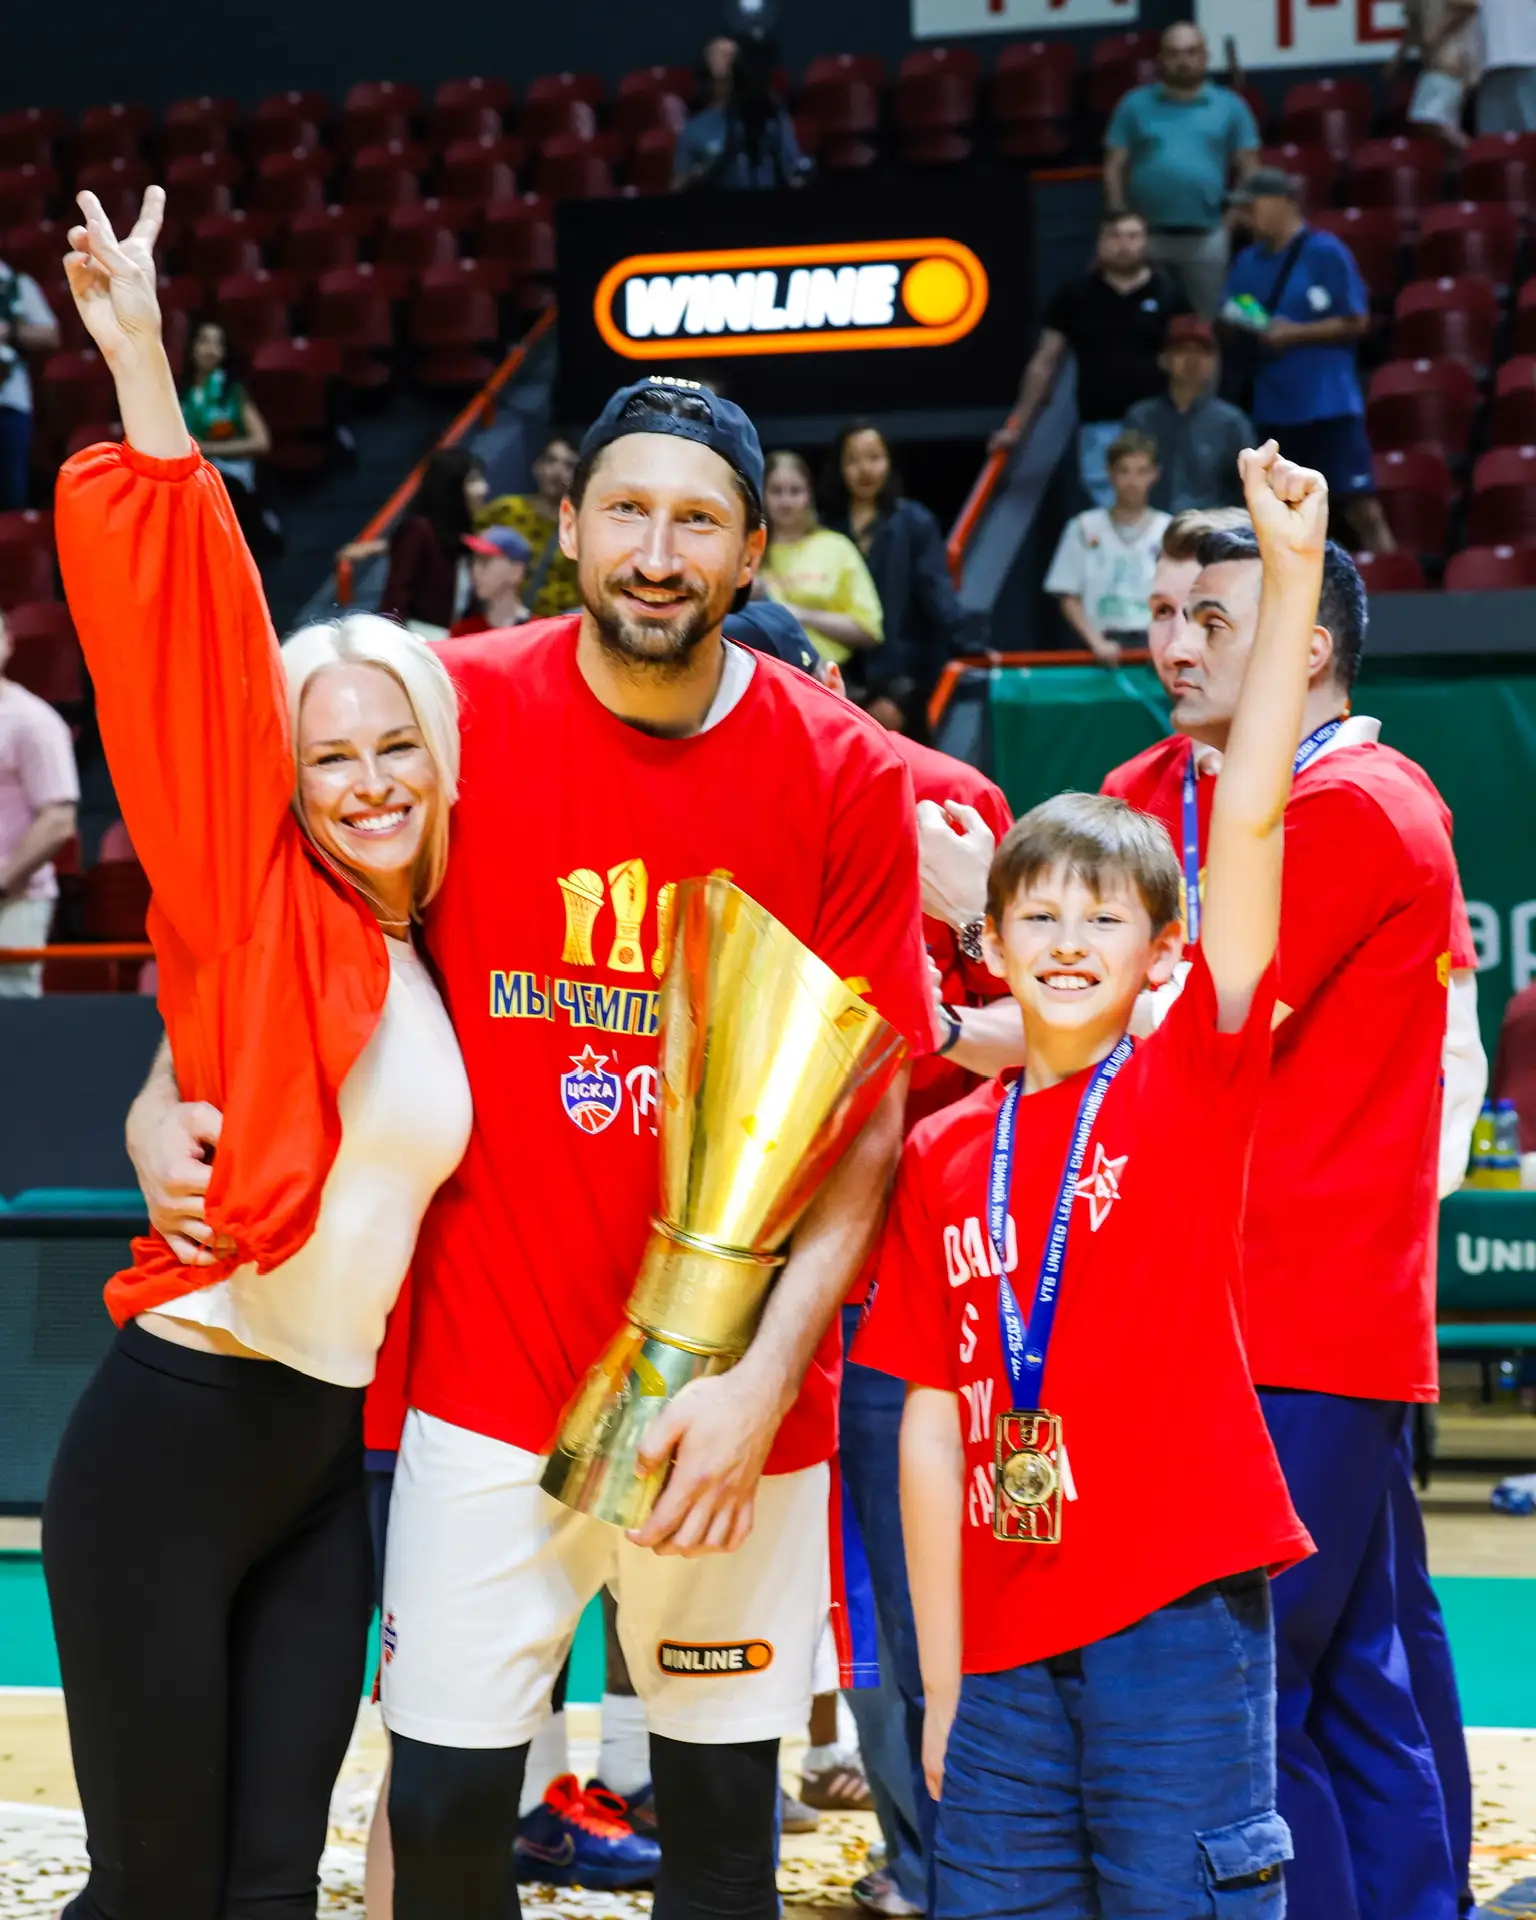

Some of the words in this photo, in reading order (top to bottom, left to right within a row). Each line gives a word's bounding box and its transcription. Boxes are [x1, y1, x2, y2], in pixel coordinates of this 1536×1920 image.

[625, 264, 900, 338] WINLINE
[490, 970, 554, 1022] МЫ
[567, 1082, 614, 1100] ЦСКА
[1069, 1077, 1110, 1168] CHAMPIONSHIP
[1057, 1171, 1080, 1221] LEAGUE
[943, 1213, 1018, 1287] DAD
[1045, 1223, 1067, 1272] UNITED
[1039, 1275, 1057, 1302] VTB
